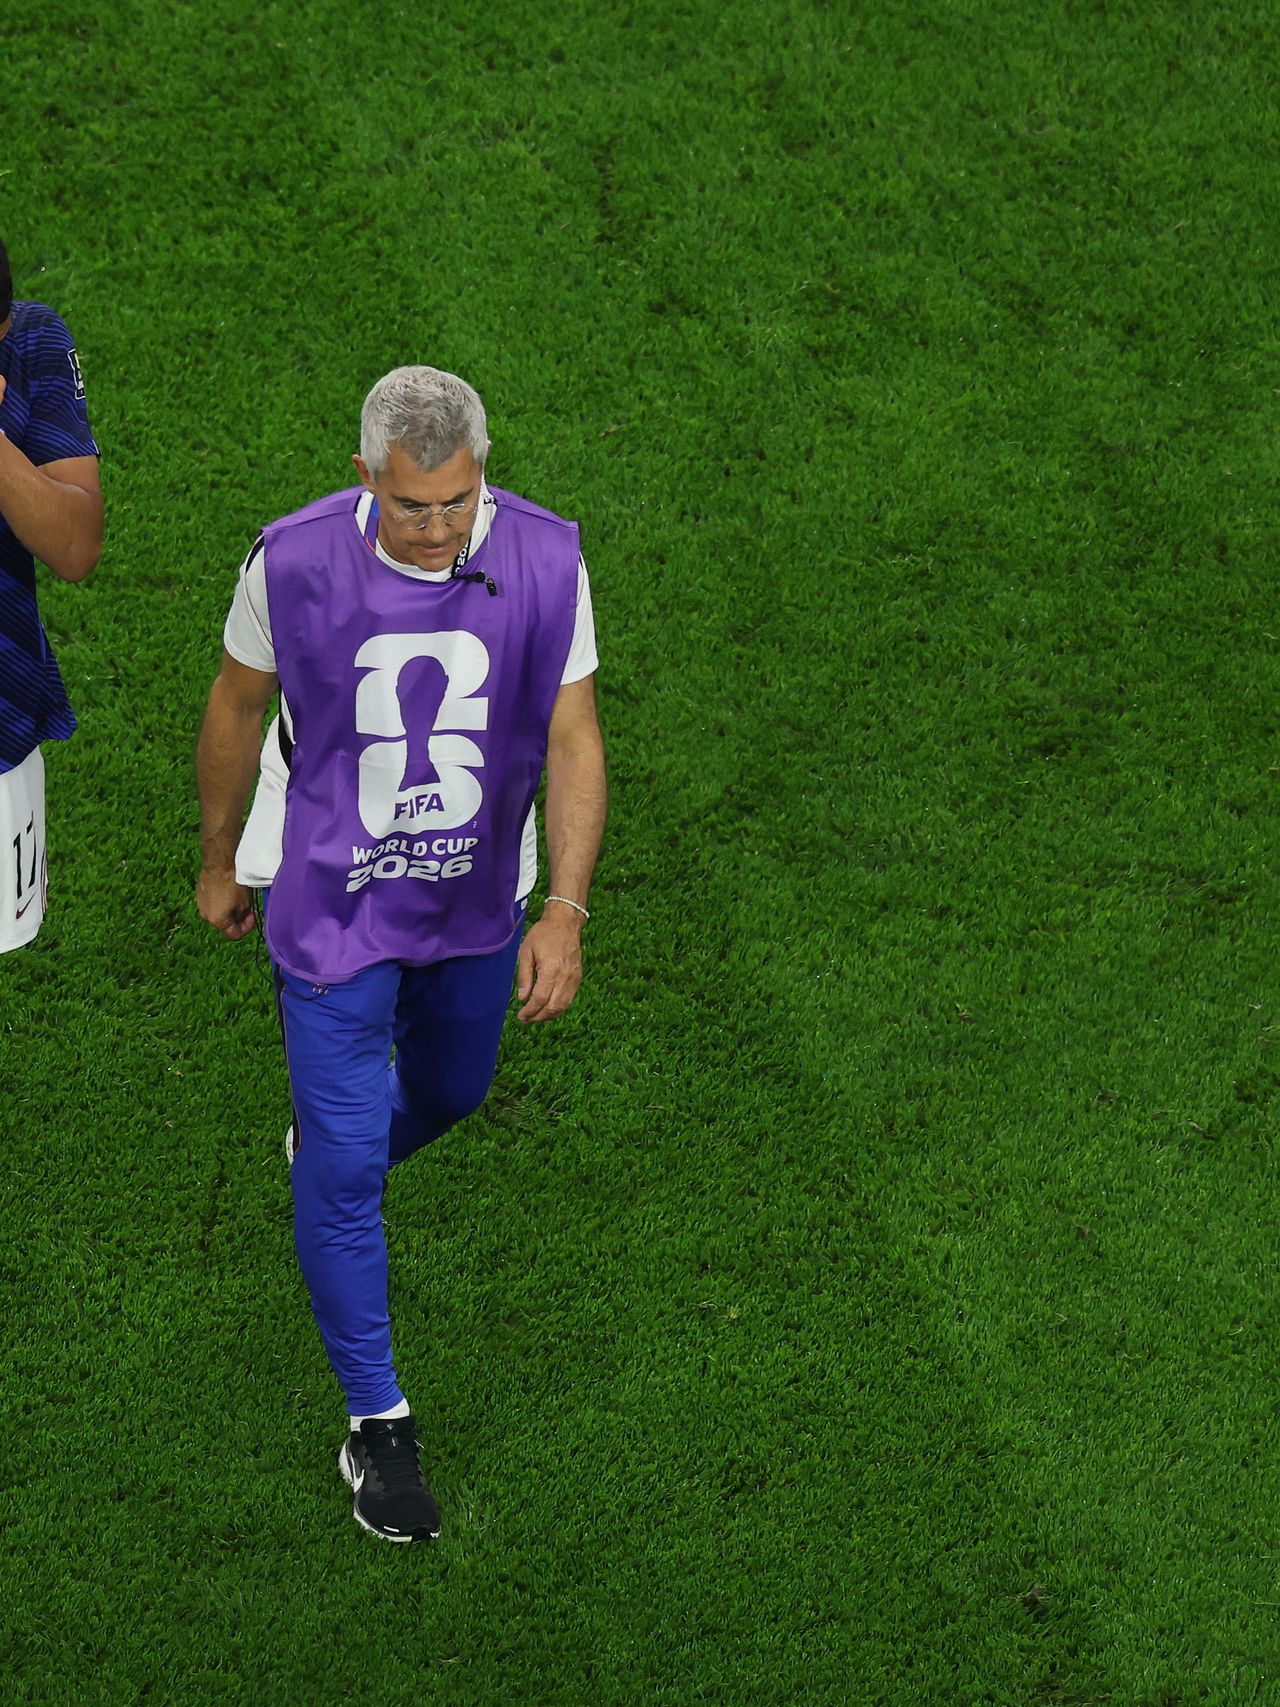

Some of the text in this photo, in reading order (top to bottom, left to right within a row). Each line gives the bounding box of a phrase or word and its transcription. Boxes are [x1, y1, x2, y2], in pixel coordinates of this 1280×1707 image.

[394, 793, 445, 821] FIFA
[352, 837, 479, 865] WORLD CUP
[346, 854, 473, 893] 2026
